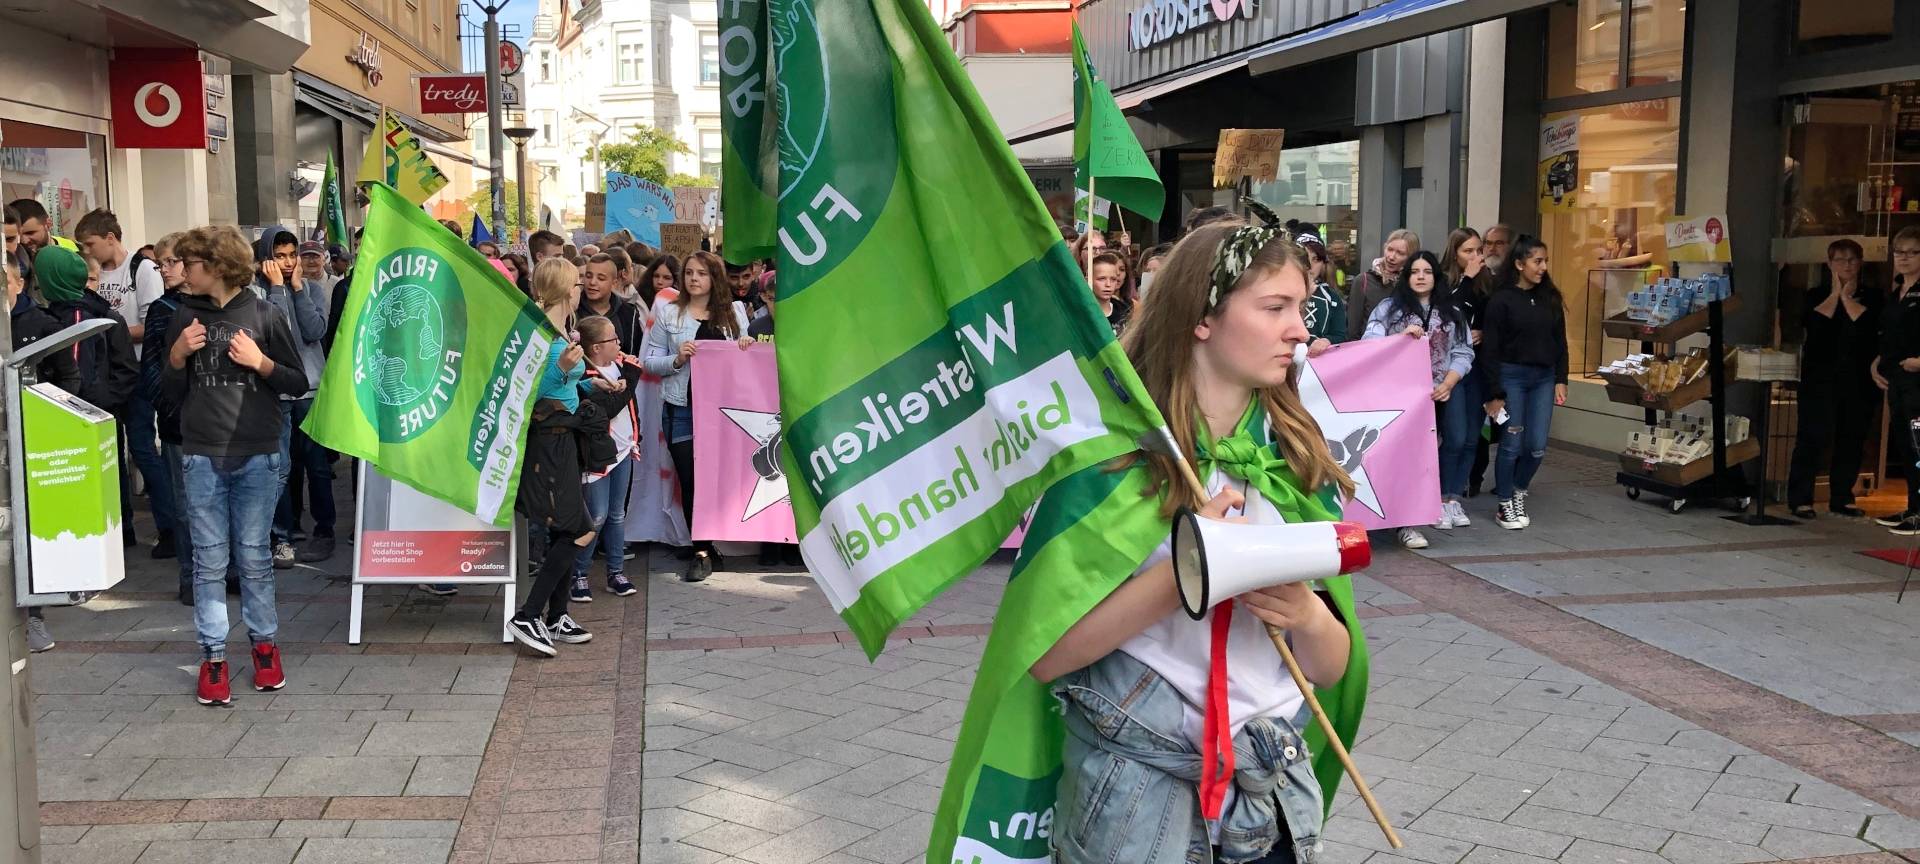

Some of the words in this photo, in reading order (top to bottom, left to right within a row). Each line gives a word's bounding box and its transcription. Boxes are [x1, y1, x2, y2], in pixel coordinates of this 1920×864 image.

[1128, 0, 1208, 53] NORDSEE
[424, 83, 484, 109] tredy
[608, 176, 631, 192] DAS
[662, 192, 674, 211] MIT
[49, 458, 69, 466] oder
[406, 549, 424, 557] Shop
[461, 548, 486, 556] Ready?
